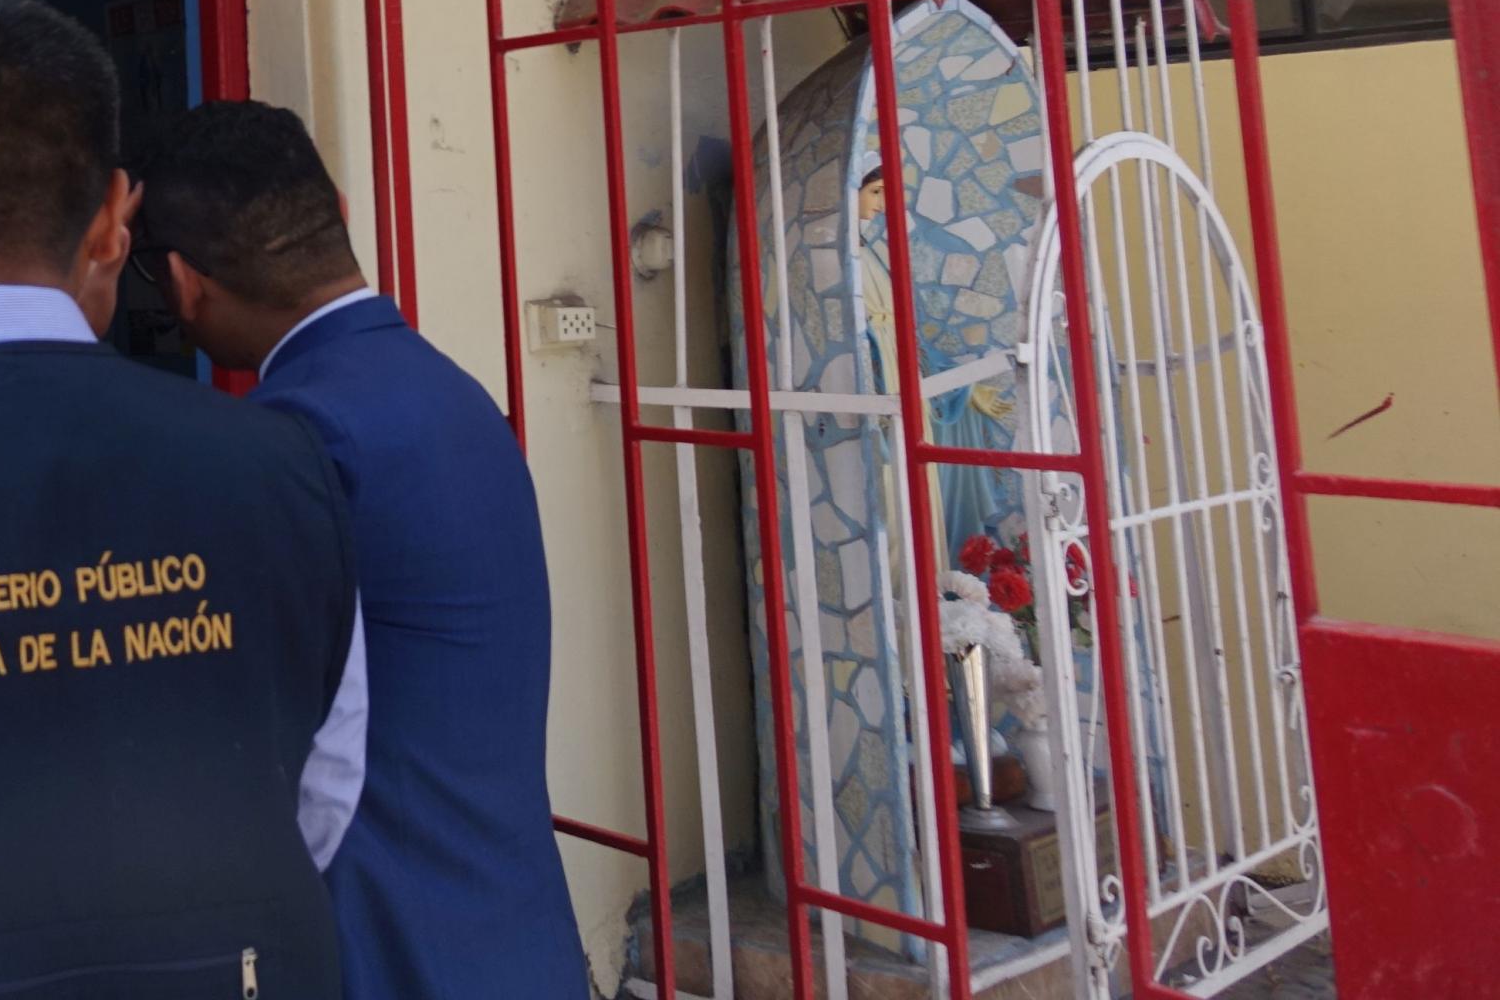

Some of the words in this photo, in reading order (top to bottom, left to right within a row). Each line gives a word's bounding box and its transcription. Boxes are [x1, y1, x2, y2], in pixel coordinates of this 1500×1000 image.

[75, 551, 206, 602] PÚBLICO
[18, 632, 58, 673] DE
[70, 630, 111, 669] LA
[124, 600, 233, 663] NACIÓN
